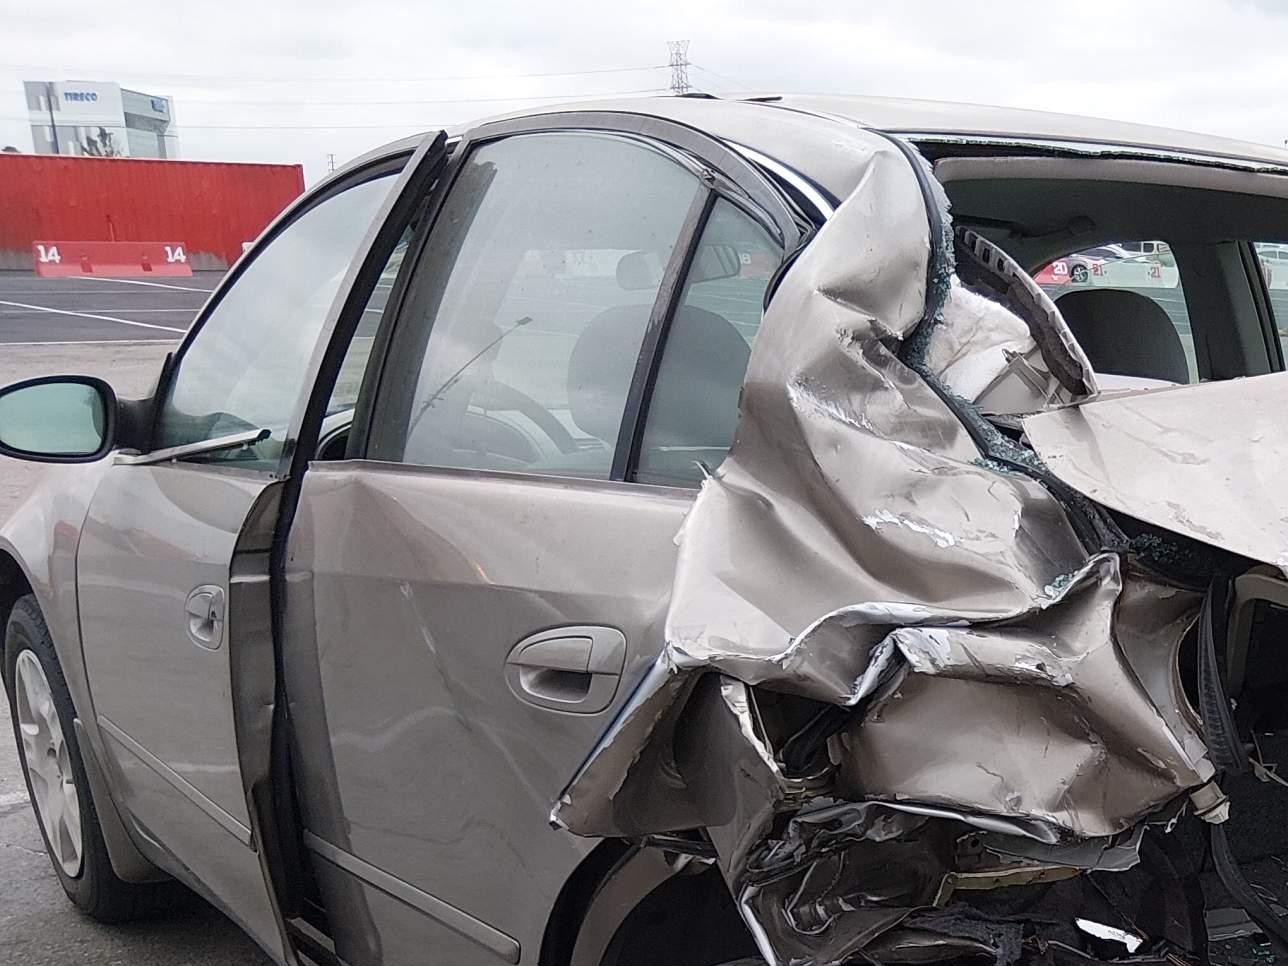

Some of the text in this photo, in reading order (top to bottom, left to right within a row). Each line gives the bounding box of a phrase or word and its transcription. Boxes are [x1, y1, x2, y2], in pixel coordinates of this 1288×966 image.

[64, 92, 98, 101] TIRECO
[37, 245, 61, 264] 14
[165, 246, 186, 263] 14
[1053, 262, 1068, 274] 20
[1092, 264, 1103, 276] 21
[1151, 266, 1160, 278] 21
